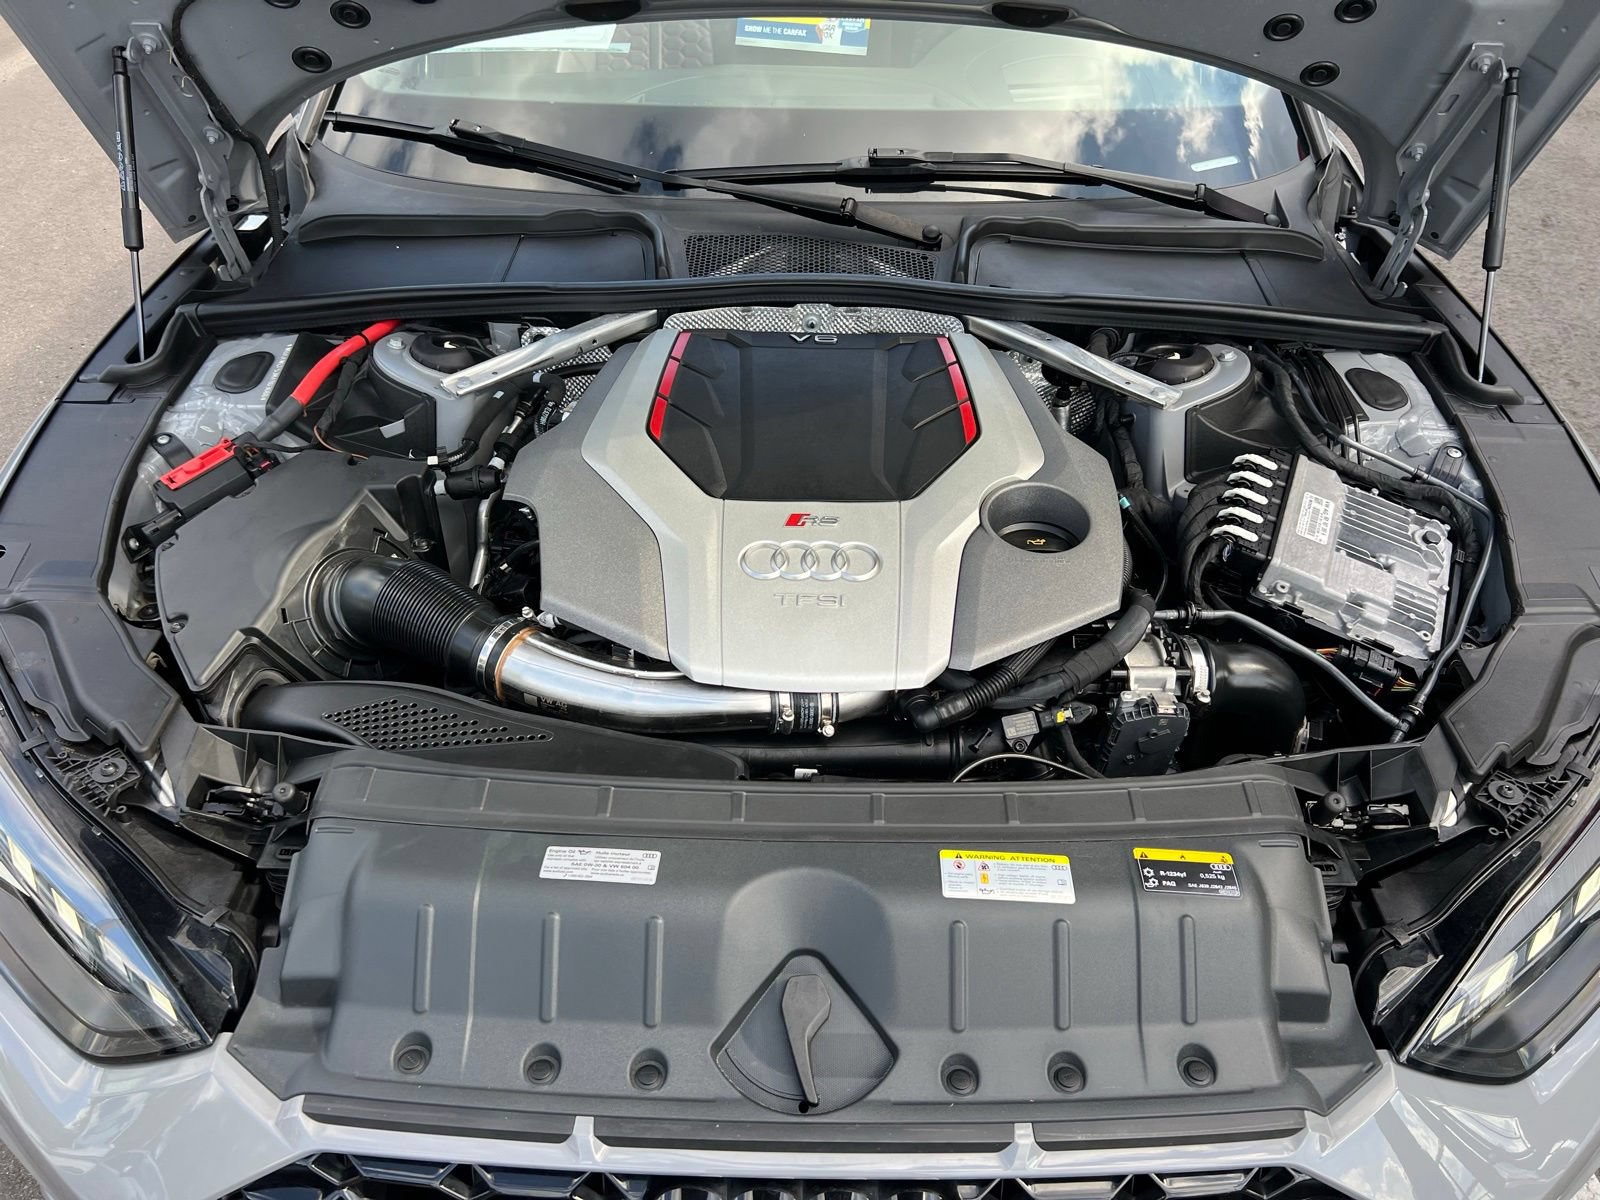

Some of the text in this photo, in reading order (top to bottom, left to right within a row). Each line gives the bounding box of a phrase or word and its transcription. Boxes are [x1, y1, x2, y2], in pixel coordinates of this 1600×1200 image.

[772, 26, 782, 34] THE
[783, 28, 806, 37] CARFAX
[790, 334, 838, 344] V6
[784, 513, 839, 528] RS
[773, 593, 844, 608] TFSI
[1010, 855, 1056, 863] ATTENTION
[1217, 873, 1226, 881] kg
